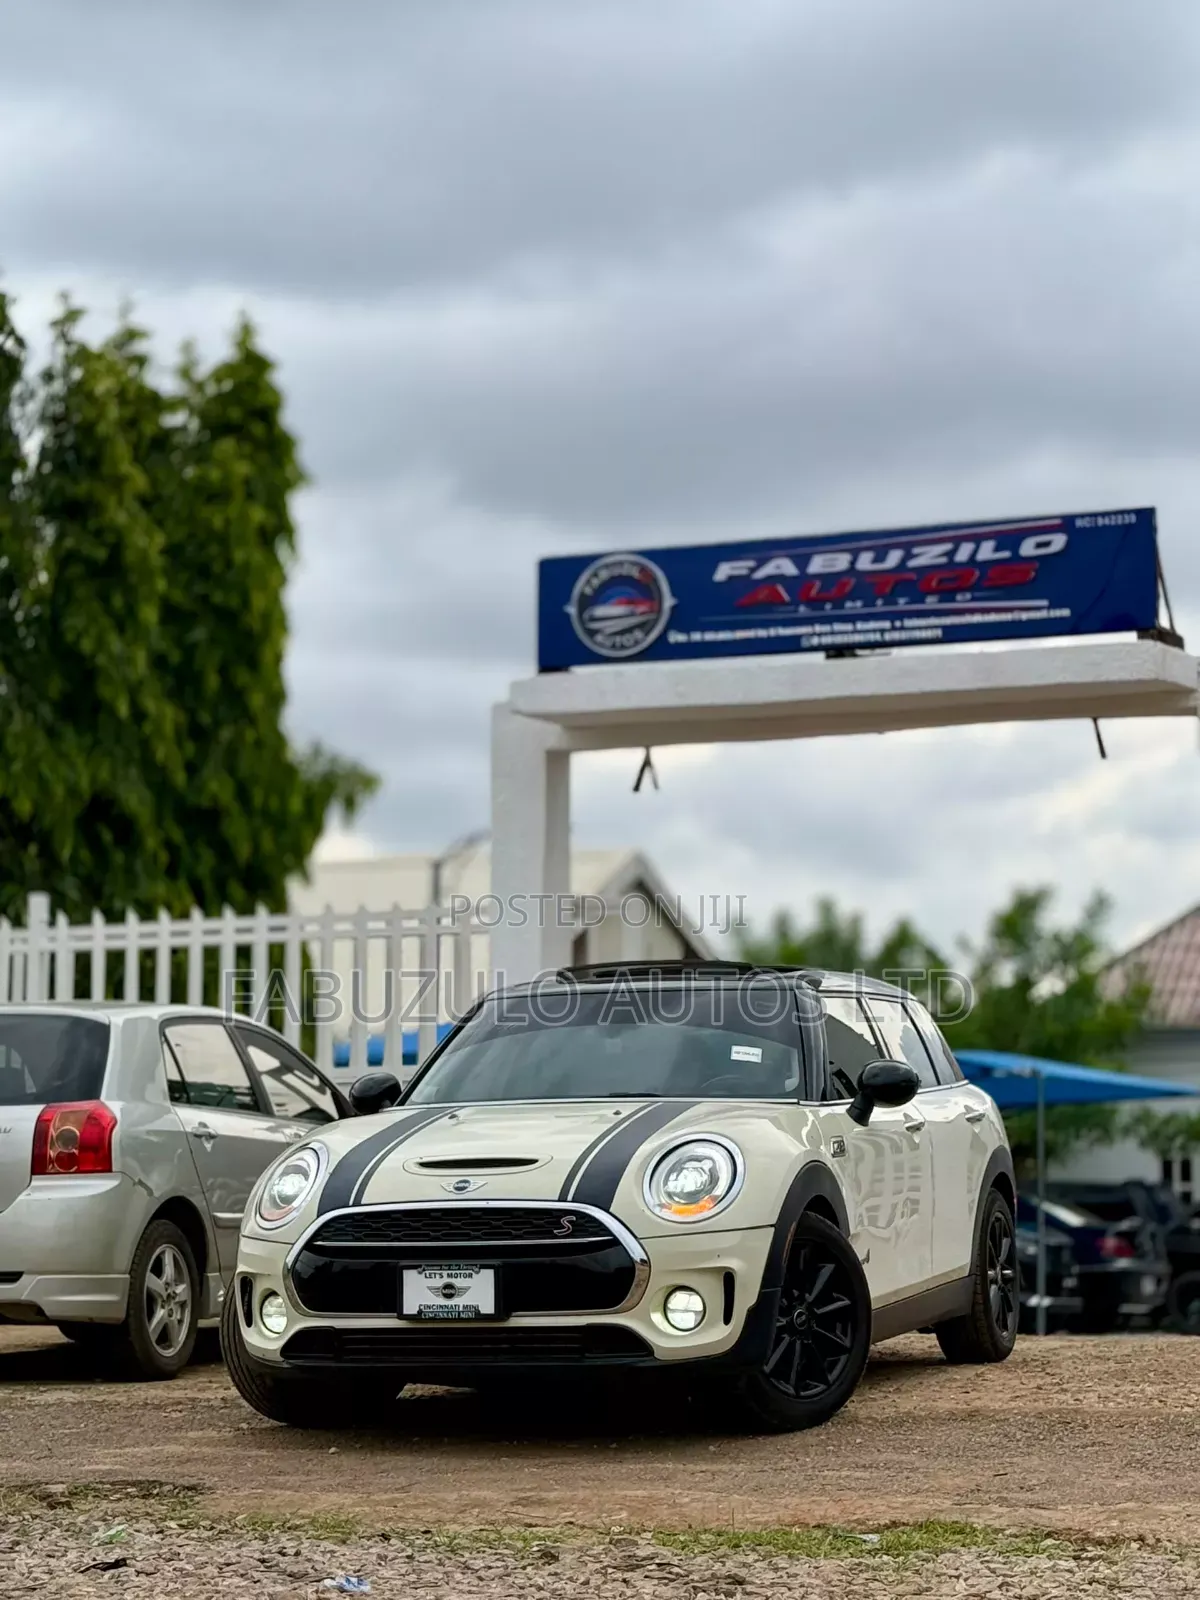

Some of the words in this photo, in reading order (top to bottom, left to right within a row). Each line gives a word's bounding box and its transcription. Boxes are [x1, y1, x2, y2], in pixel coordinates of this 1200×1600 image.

[712, 532, 1068, 582] FABUZILO
[734, 562, 1039, 607] AUTOS
[554, 1216, 576, 1236] S
[460, 1311, 476, 1319] MINI
